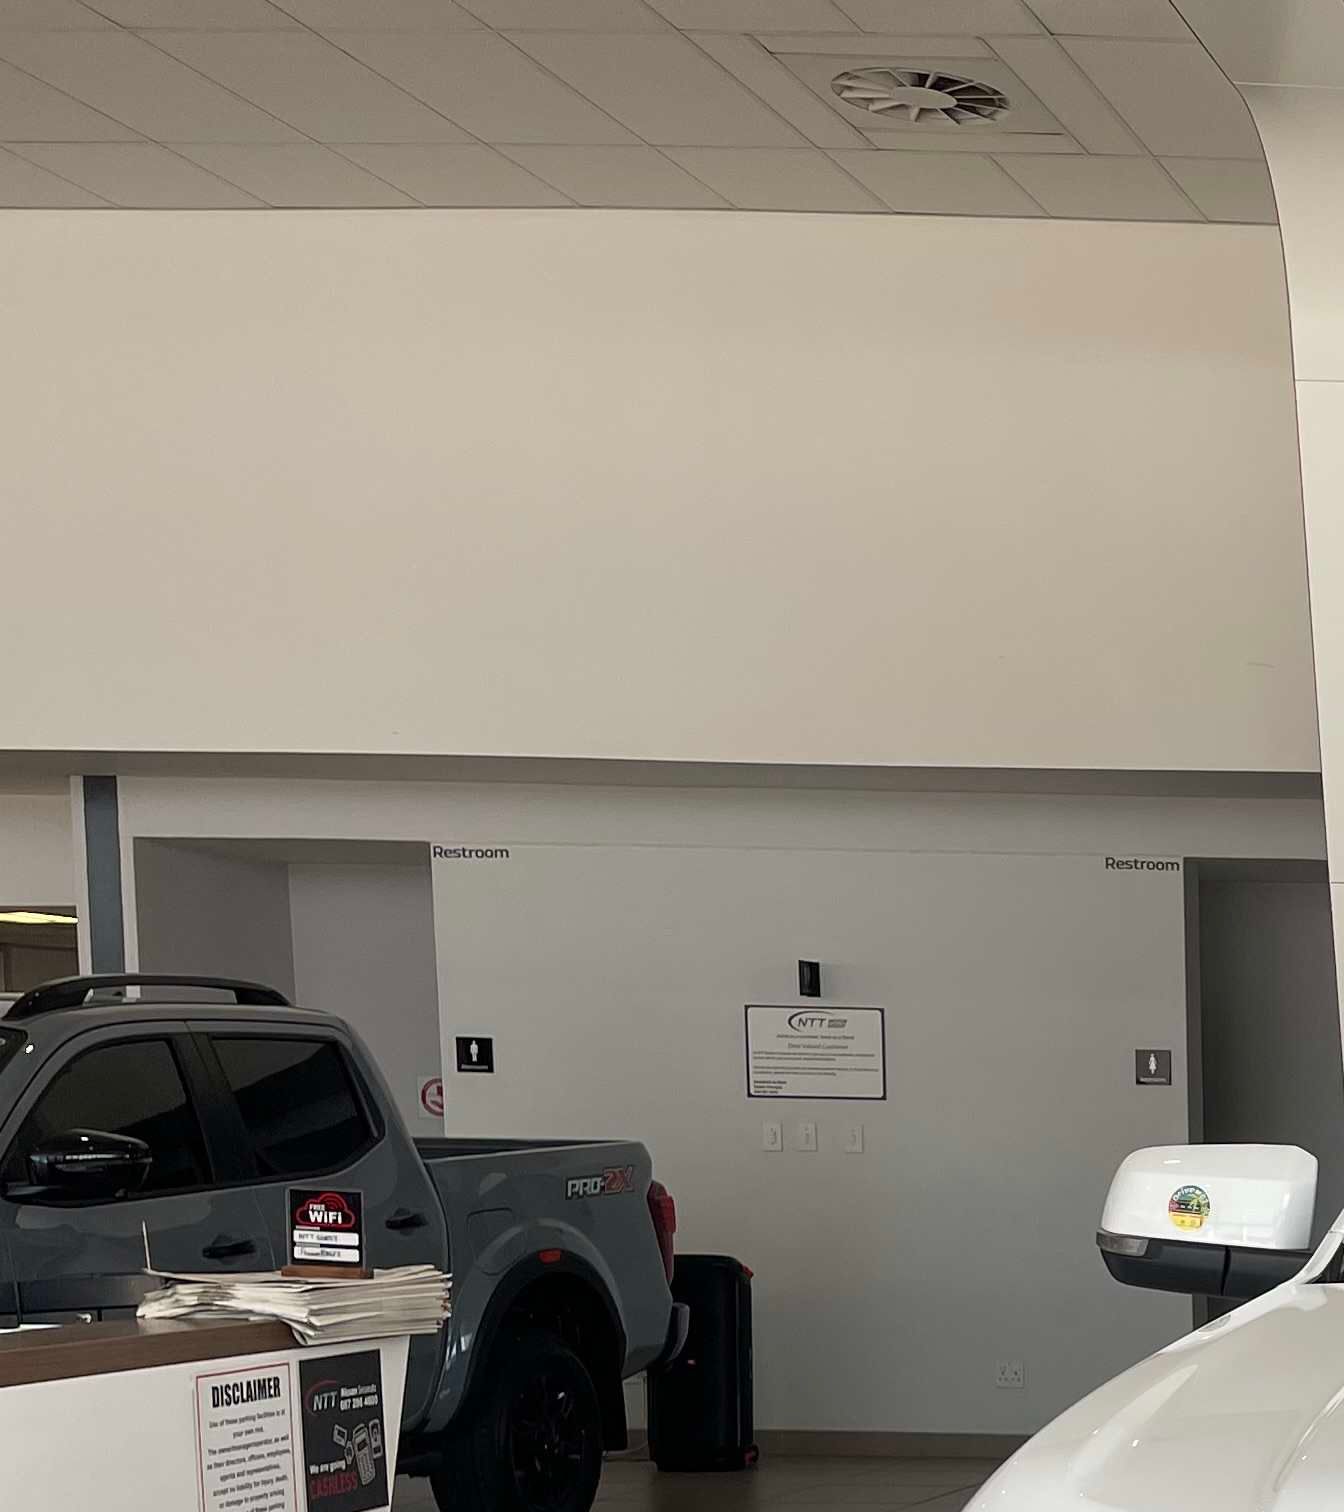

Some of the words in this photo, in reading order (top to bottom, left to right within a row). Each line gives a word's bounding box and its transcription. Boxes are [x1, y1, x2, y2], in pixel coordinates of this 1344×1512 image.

[433, 846, 510, 858] Restroom
[1105, 857, 1180, 871] Restroom
[797, 1017, 827, 1028] NTT
[211, 1376, 281, 1409] DISCLAIMER
[313, 1390, 338, 1412] NTT
